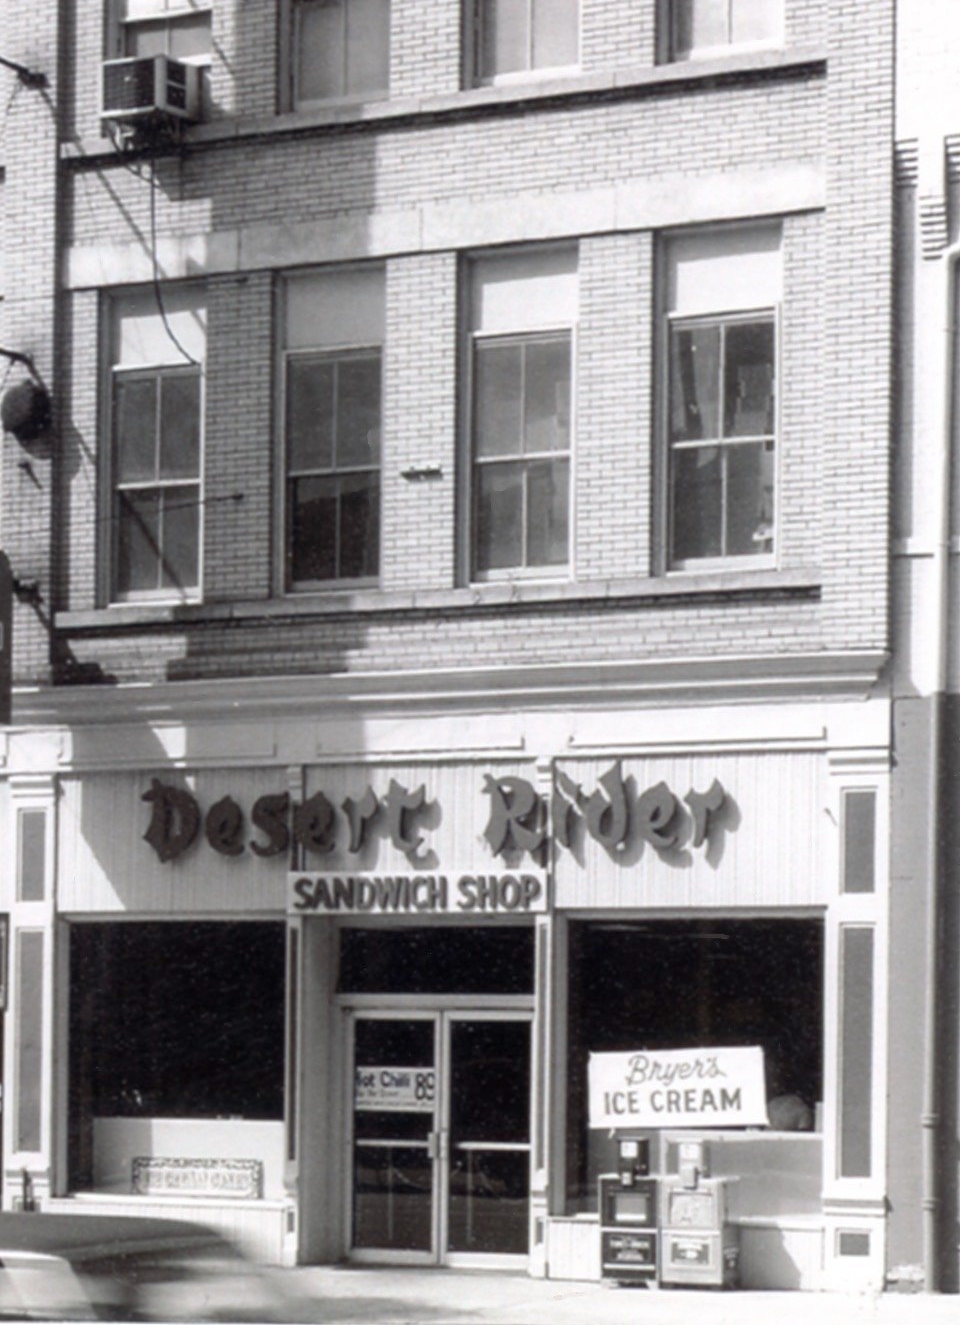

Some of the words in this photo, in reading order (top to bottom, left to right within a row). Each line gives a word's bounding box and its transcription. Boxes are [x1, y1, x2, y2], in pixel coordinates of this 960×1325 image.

[141, 776, 428, 864] Desert
[482, 760, 730, 858] Rider
[293, 874, 447, 911] SANDWICH
[456, 874, 540, 910] SHOP
[625, 1054, 728, 1087] Bryer's
[603, 1090, 641, 1116] ICE
[649, 1087, 743, 1113] CREAM
